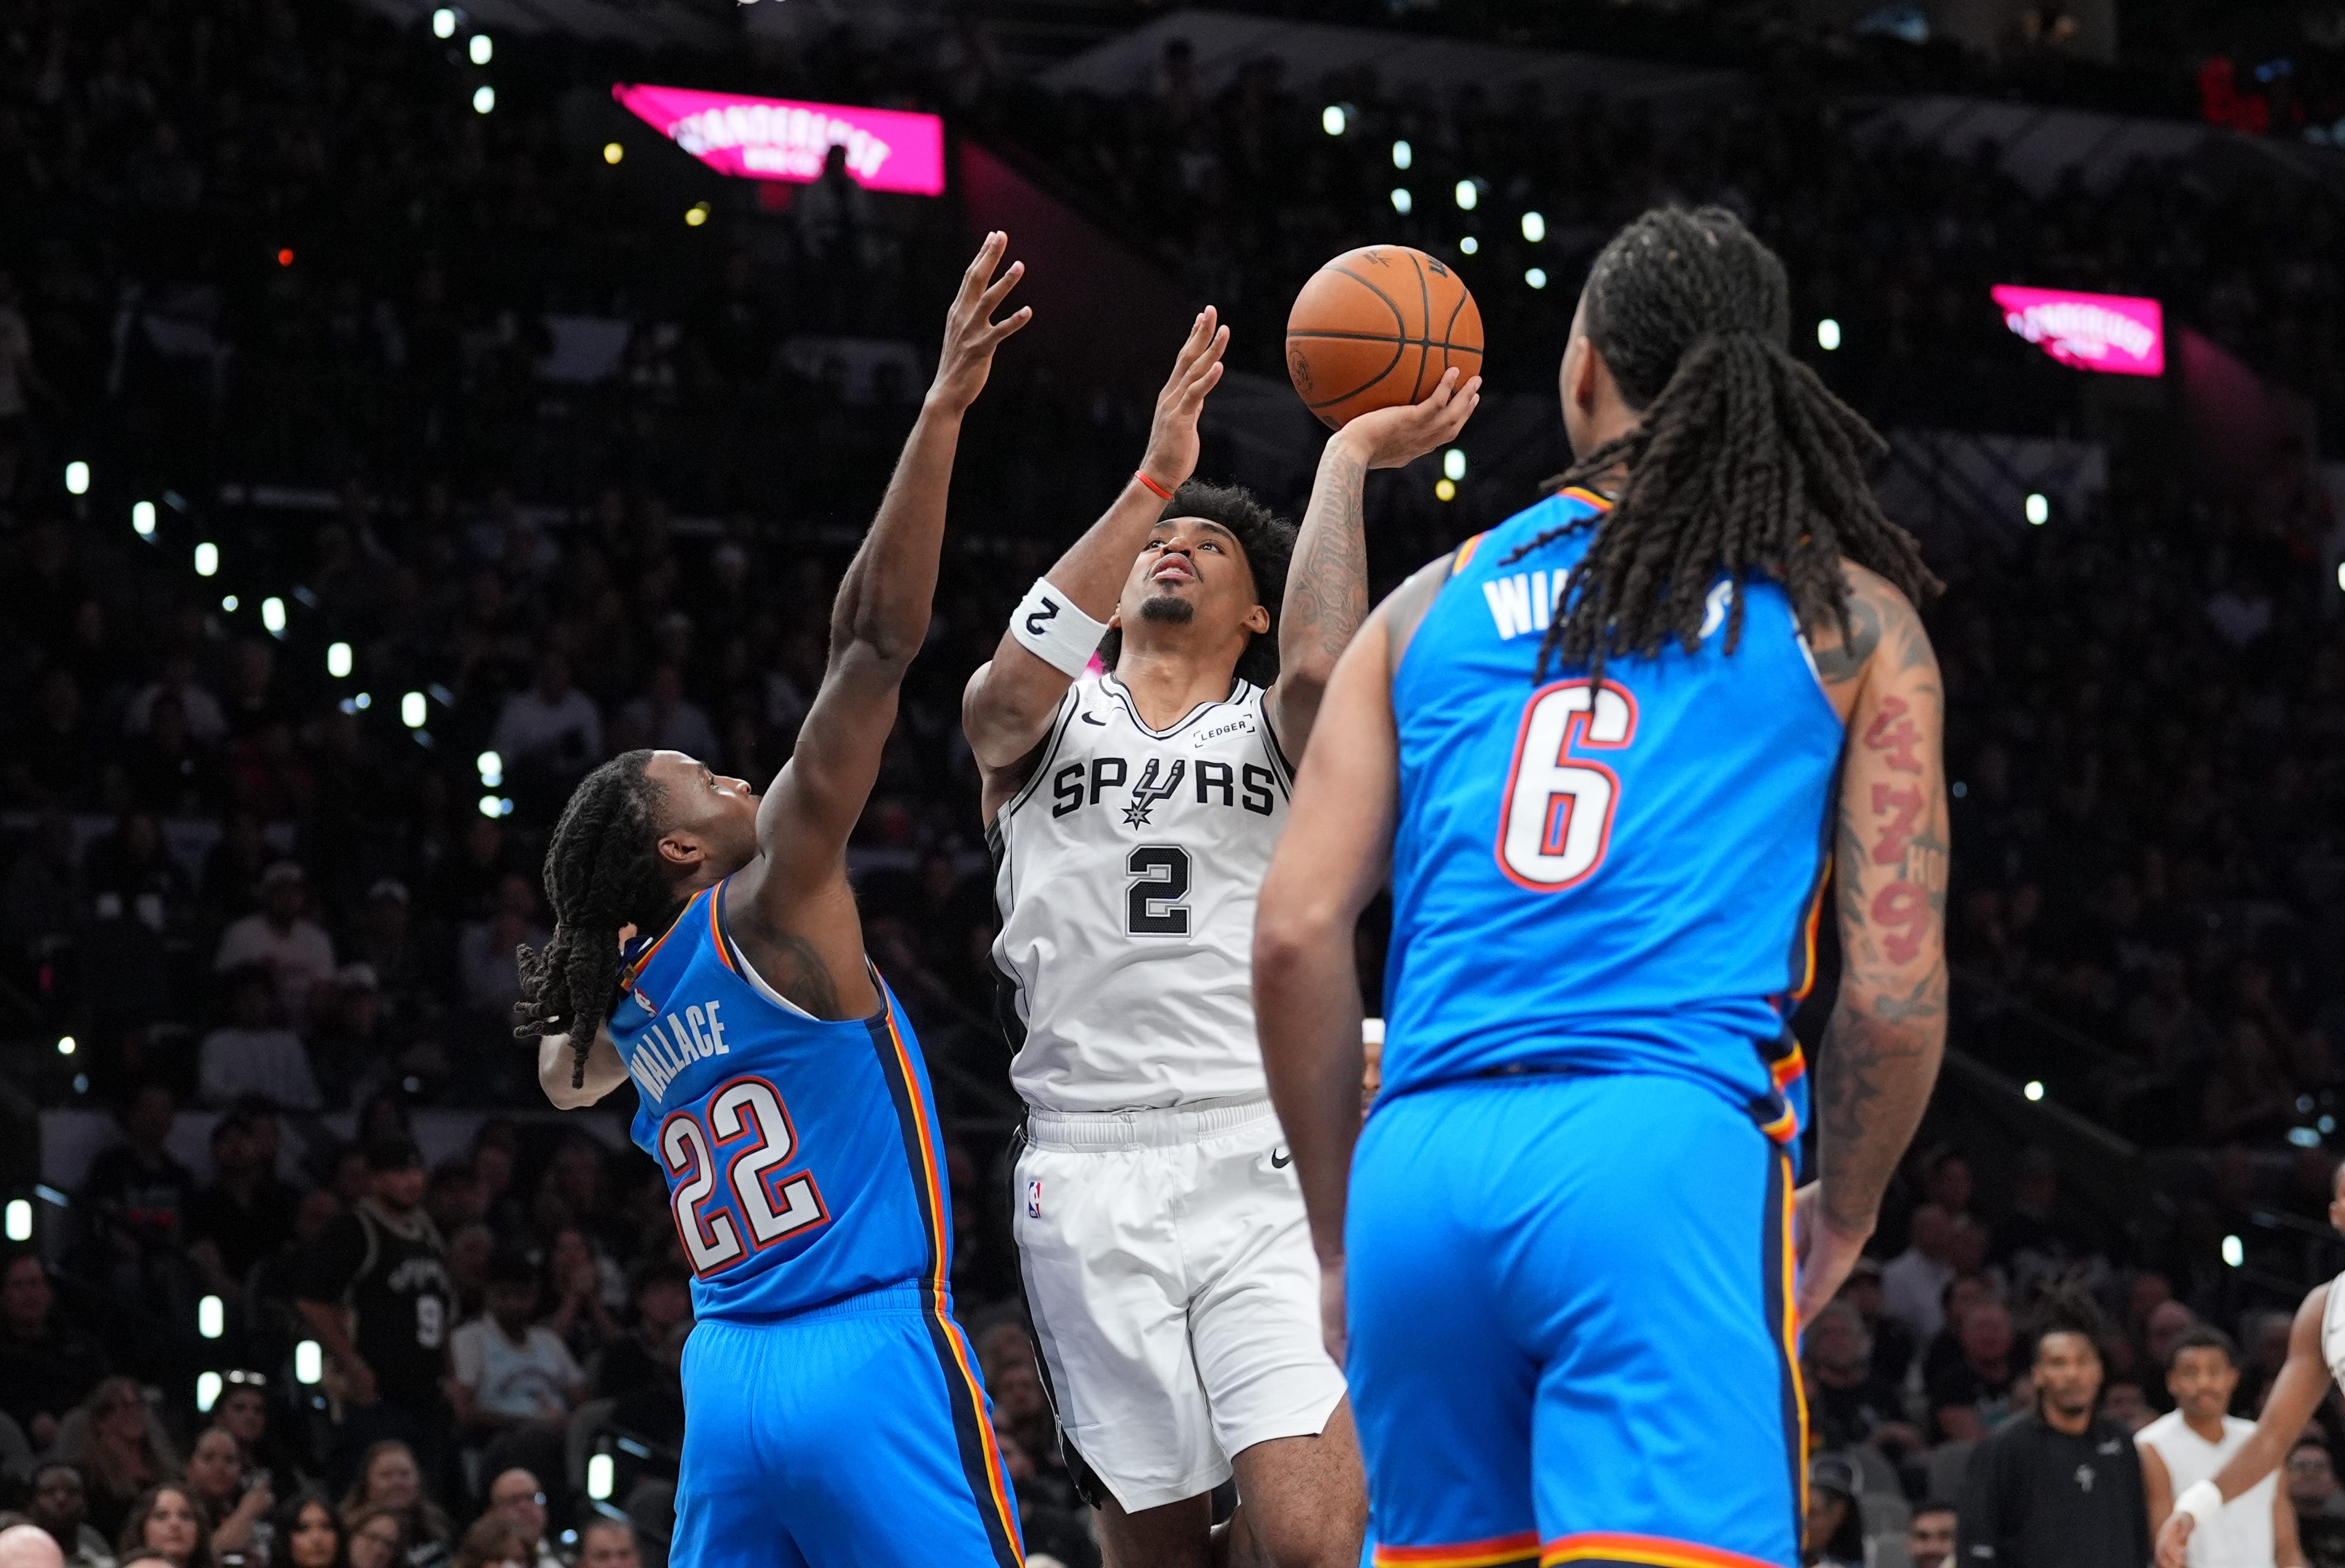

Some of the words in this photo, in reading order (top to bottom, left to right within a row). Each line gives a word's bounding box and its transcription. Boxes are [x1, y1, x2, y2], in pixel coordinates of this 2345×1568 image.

[1026, 596, 1060, 635] 2
[1201, 721, 1246, 741] LEDGER
[1052, 757, 1276, 830] SPURS
[1495, 677, 1639, 894] 6
[1124, 843, 1192, 938] 2
[629, 1000, 730, 1105] WALLACE
[659, 1075, 831, 1280] 22
